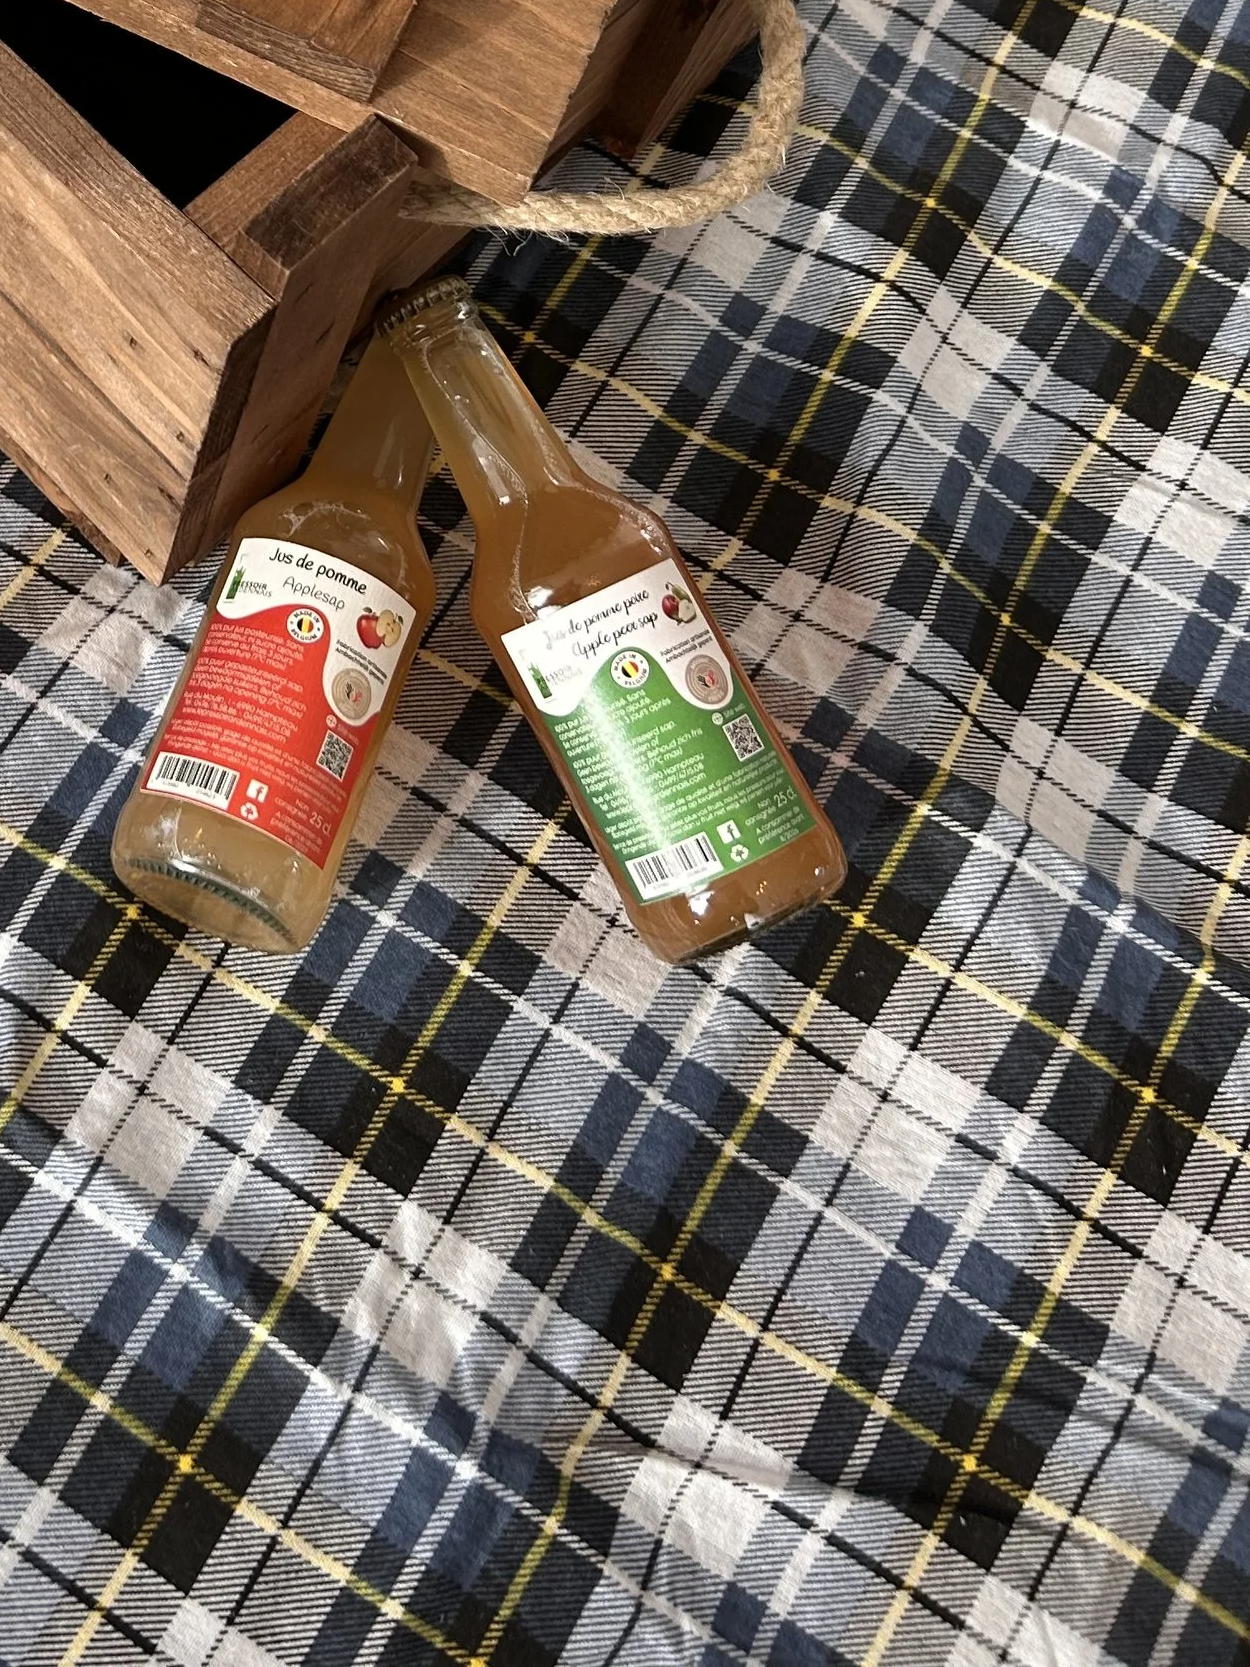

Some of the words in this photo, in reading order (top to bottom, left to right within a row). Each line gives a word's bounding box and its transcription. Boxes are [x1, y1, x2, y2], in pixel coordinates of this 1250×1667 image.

[268, 547, 293, 564] Jus
[295, 553, 313, 570] de
[315, 565, 366, 593] pomme
[282, 576, 344, 610] Applesap
[568, 618, 581, 633] de
[583, 603, 621, 633] pomme
[622, 590, 649, 615] poire
[571, 632, 610, 659] Apple
[637, 612, 658, 628] sap
[609, 654, 626, 671] MADE
[624, 668, 650, 688] BELGIUM
[773, 791, 787, 807] 25
[309, 811, 322, 828] 25
